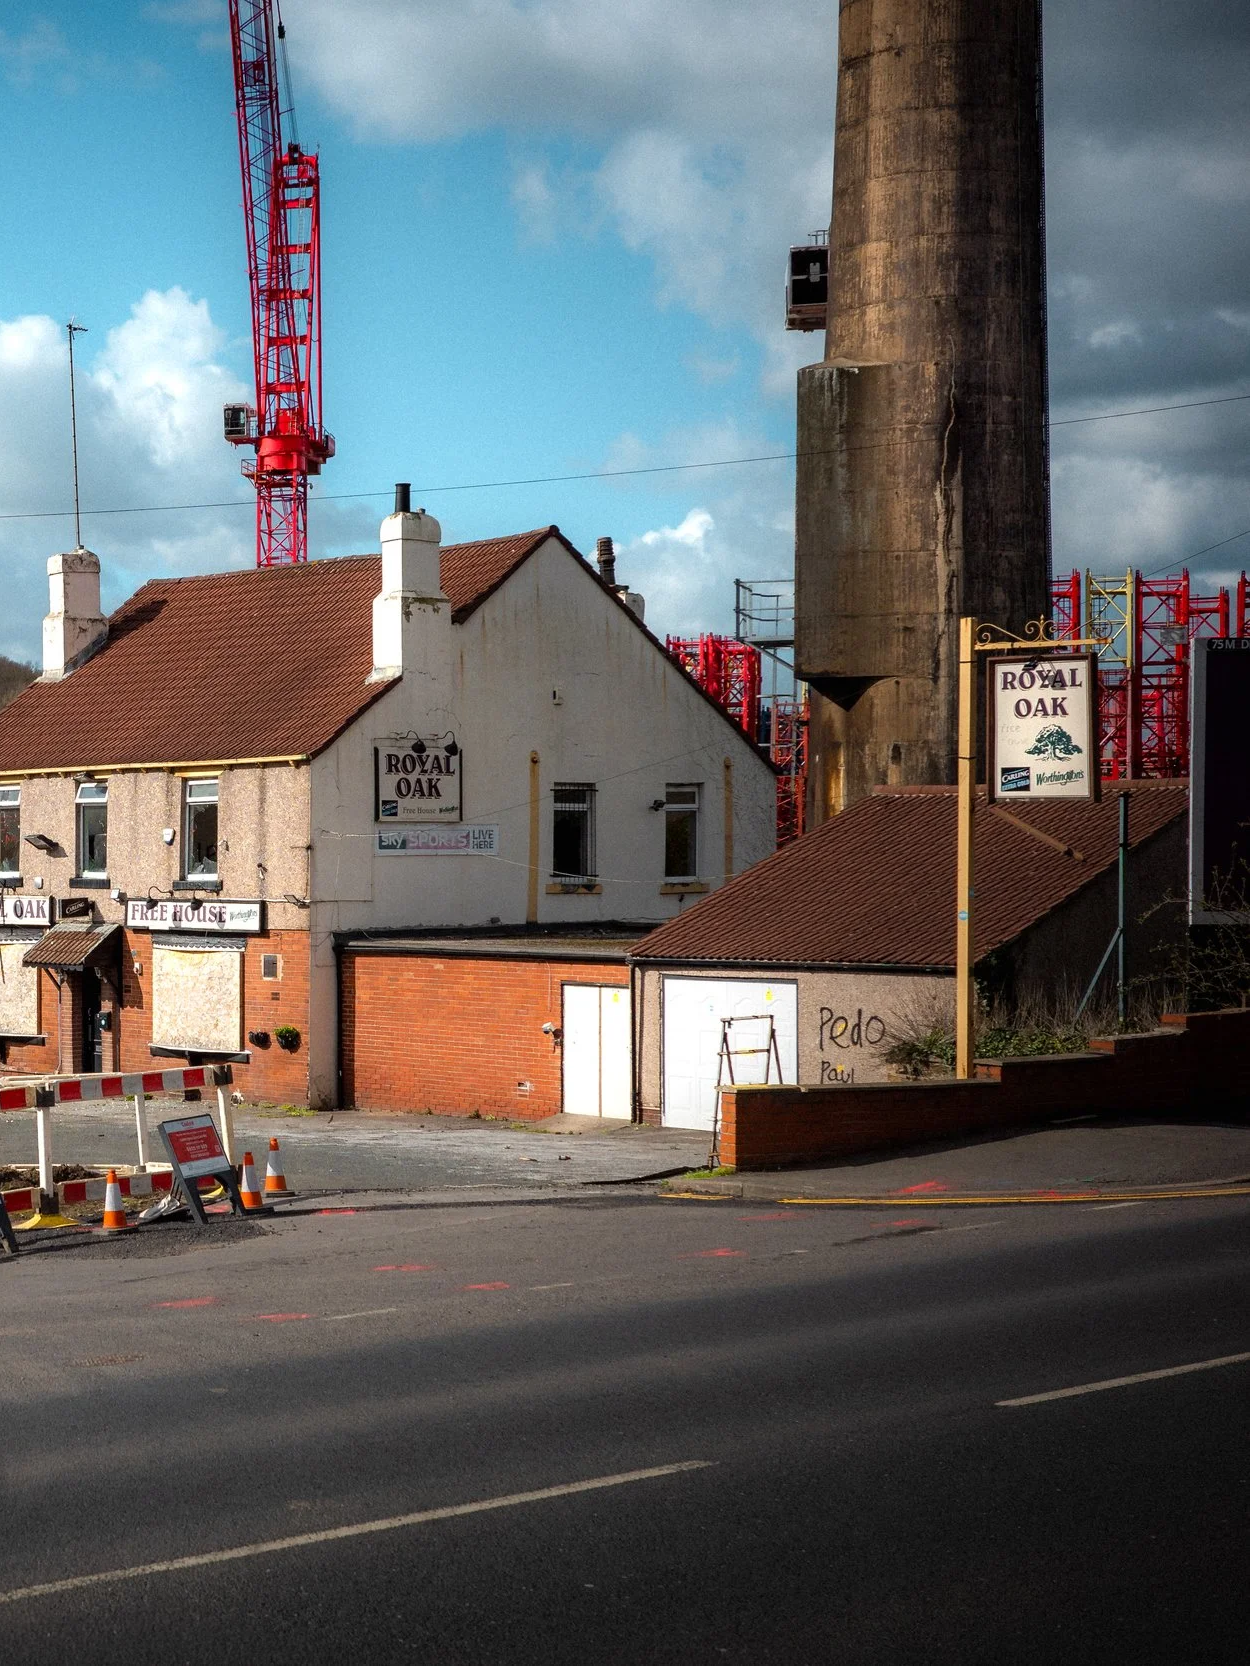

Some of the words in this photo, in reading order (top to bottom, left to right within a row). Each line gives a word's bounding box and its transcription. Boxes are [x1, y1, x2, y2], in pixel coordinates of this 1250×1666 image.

[1211, 639, 1235, 649] 75M
[1241, 639, 1250, 649] D
[1001, 668, 1082, 692] ROYAL
[1013, 696, 1069, 719] OAK
[385, 753, 455, 776] ROYAL
[1001, 769, 1030, 783] CARLING
[395, 777, 442, 799] OAK
[402, 806, 416, 814] Free
[418, 806, 436, 814] House
[381, 833, 403, 849] sky
[408, 832, 468, 847] SPORTS
[472, 829, 494, 839] LIVE
[472, 840, 494, 850] HERE
[13, 899, 47, 919] OAK
[65, 901, 85, 914] CARLING
[131, 903, 168, 921] FREE
[173, 905, 227, 923] HOUSE
[820, 1007, 886, 1051] Pedo
[820, 1060, 854, 1084] Paul
